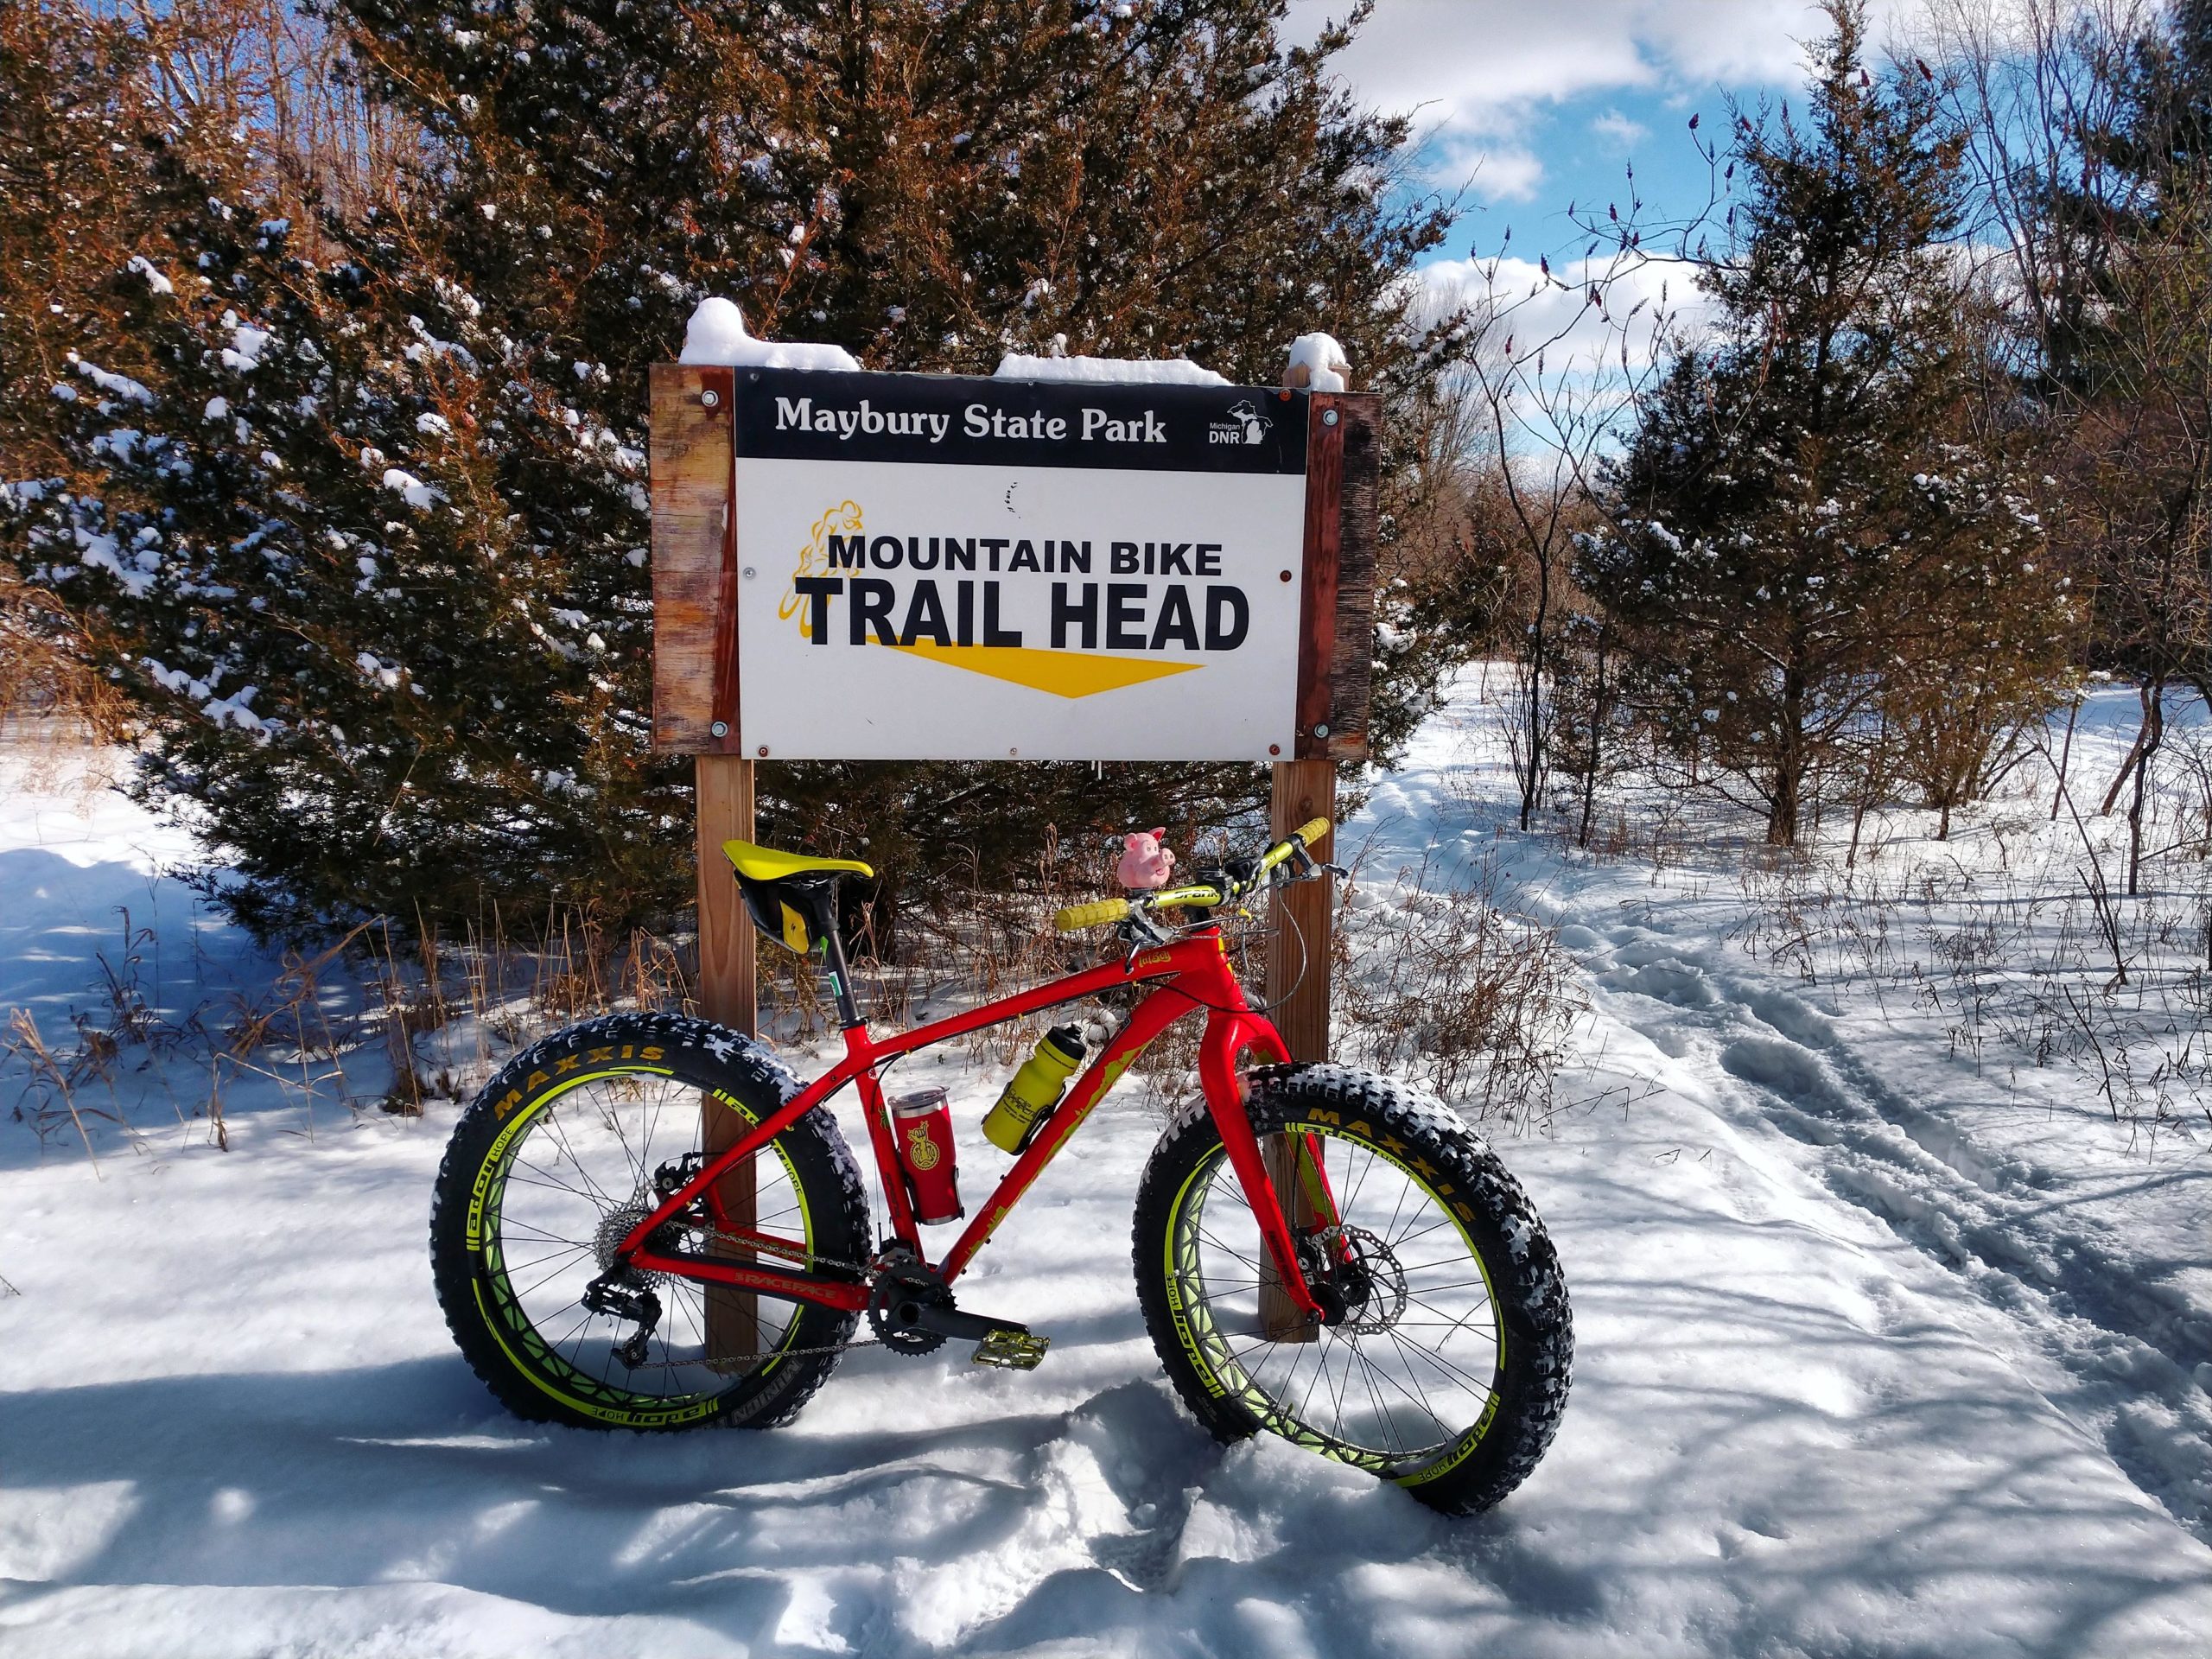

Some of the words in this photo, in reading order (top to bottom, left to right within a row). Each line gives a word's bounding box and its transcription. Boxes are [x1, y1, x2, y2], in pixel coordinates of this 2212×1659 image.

[774, 397, 950, 443] Maybury
[963, 404, 1067, 440] State
[1080, 408, 1166, 443] Park
[1209, 430, 1240, 444] DNR
[1210, 423, 1240, 431] Michigan
[828, 535, 1091, 573] MOUNTAIN
[1109, 542, 1223, 576] BIKE
[795, 576, 1022, 647] TRAIL
[1051, 582, 1249, 651] HEAD
[494, 1044, 665, 1121] MAXXIS
[492, 1127, 514, 1157] HOPE
[1307, 1108, 1476, 1223] MAXXIS
[593, 1408, 624, 1421] HOPE
